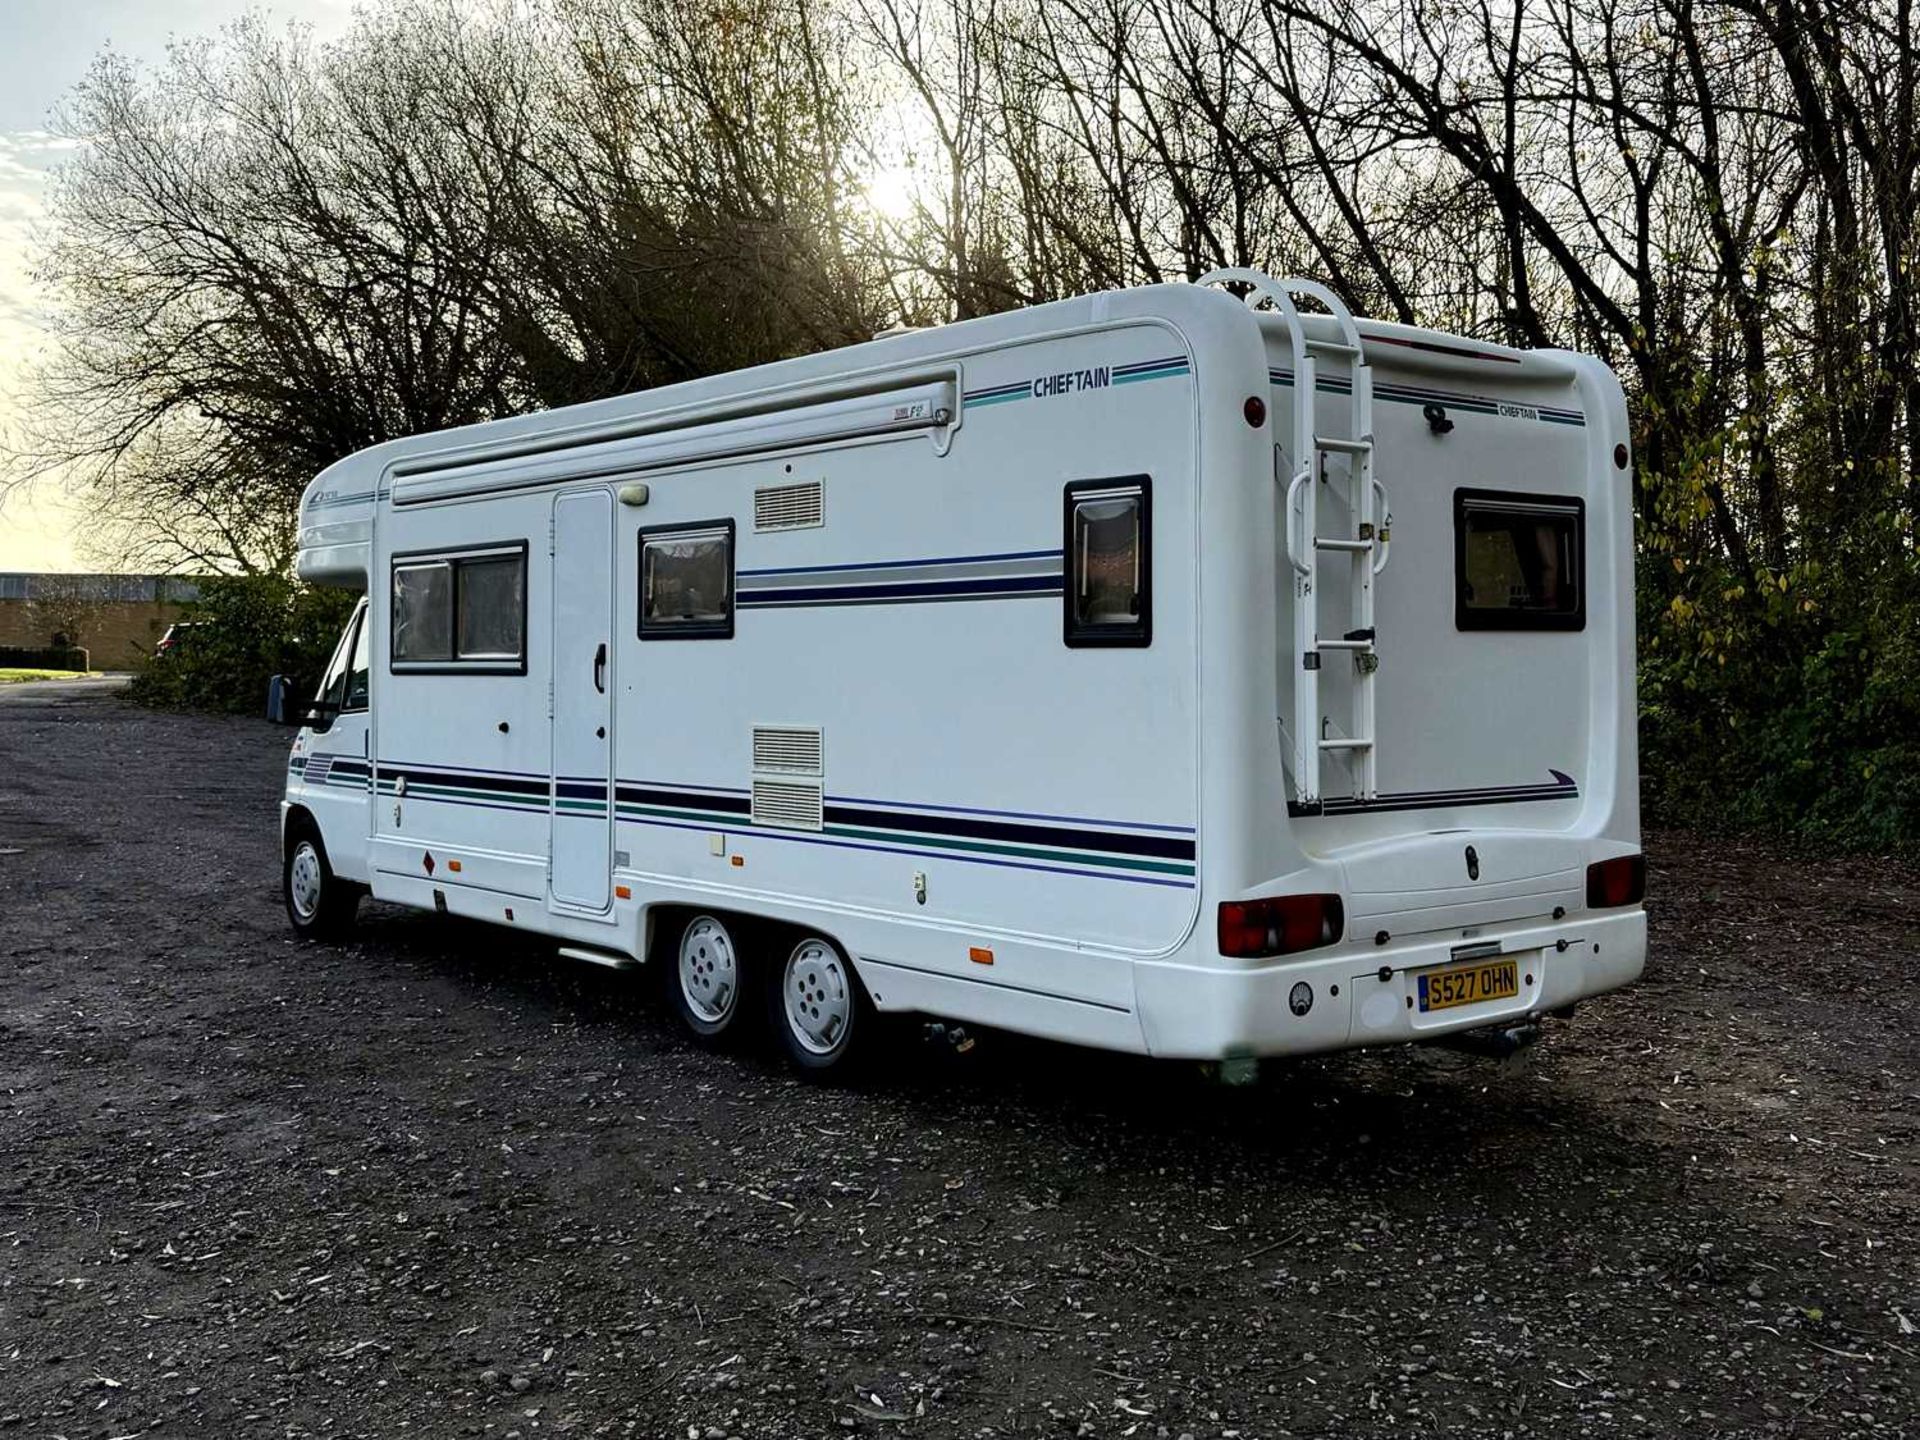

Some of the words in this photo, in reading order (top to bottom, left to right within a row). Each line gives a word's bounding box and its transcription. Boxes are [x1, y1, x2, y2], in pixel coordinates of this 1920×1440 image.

[1033, 367, 1110, 397] CHIEFTAIN
[1430, 972, 1476, 1005] S527
[1480, 966, 1515, 996] OHN
